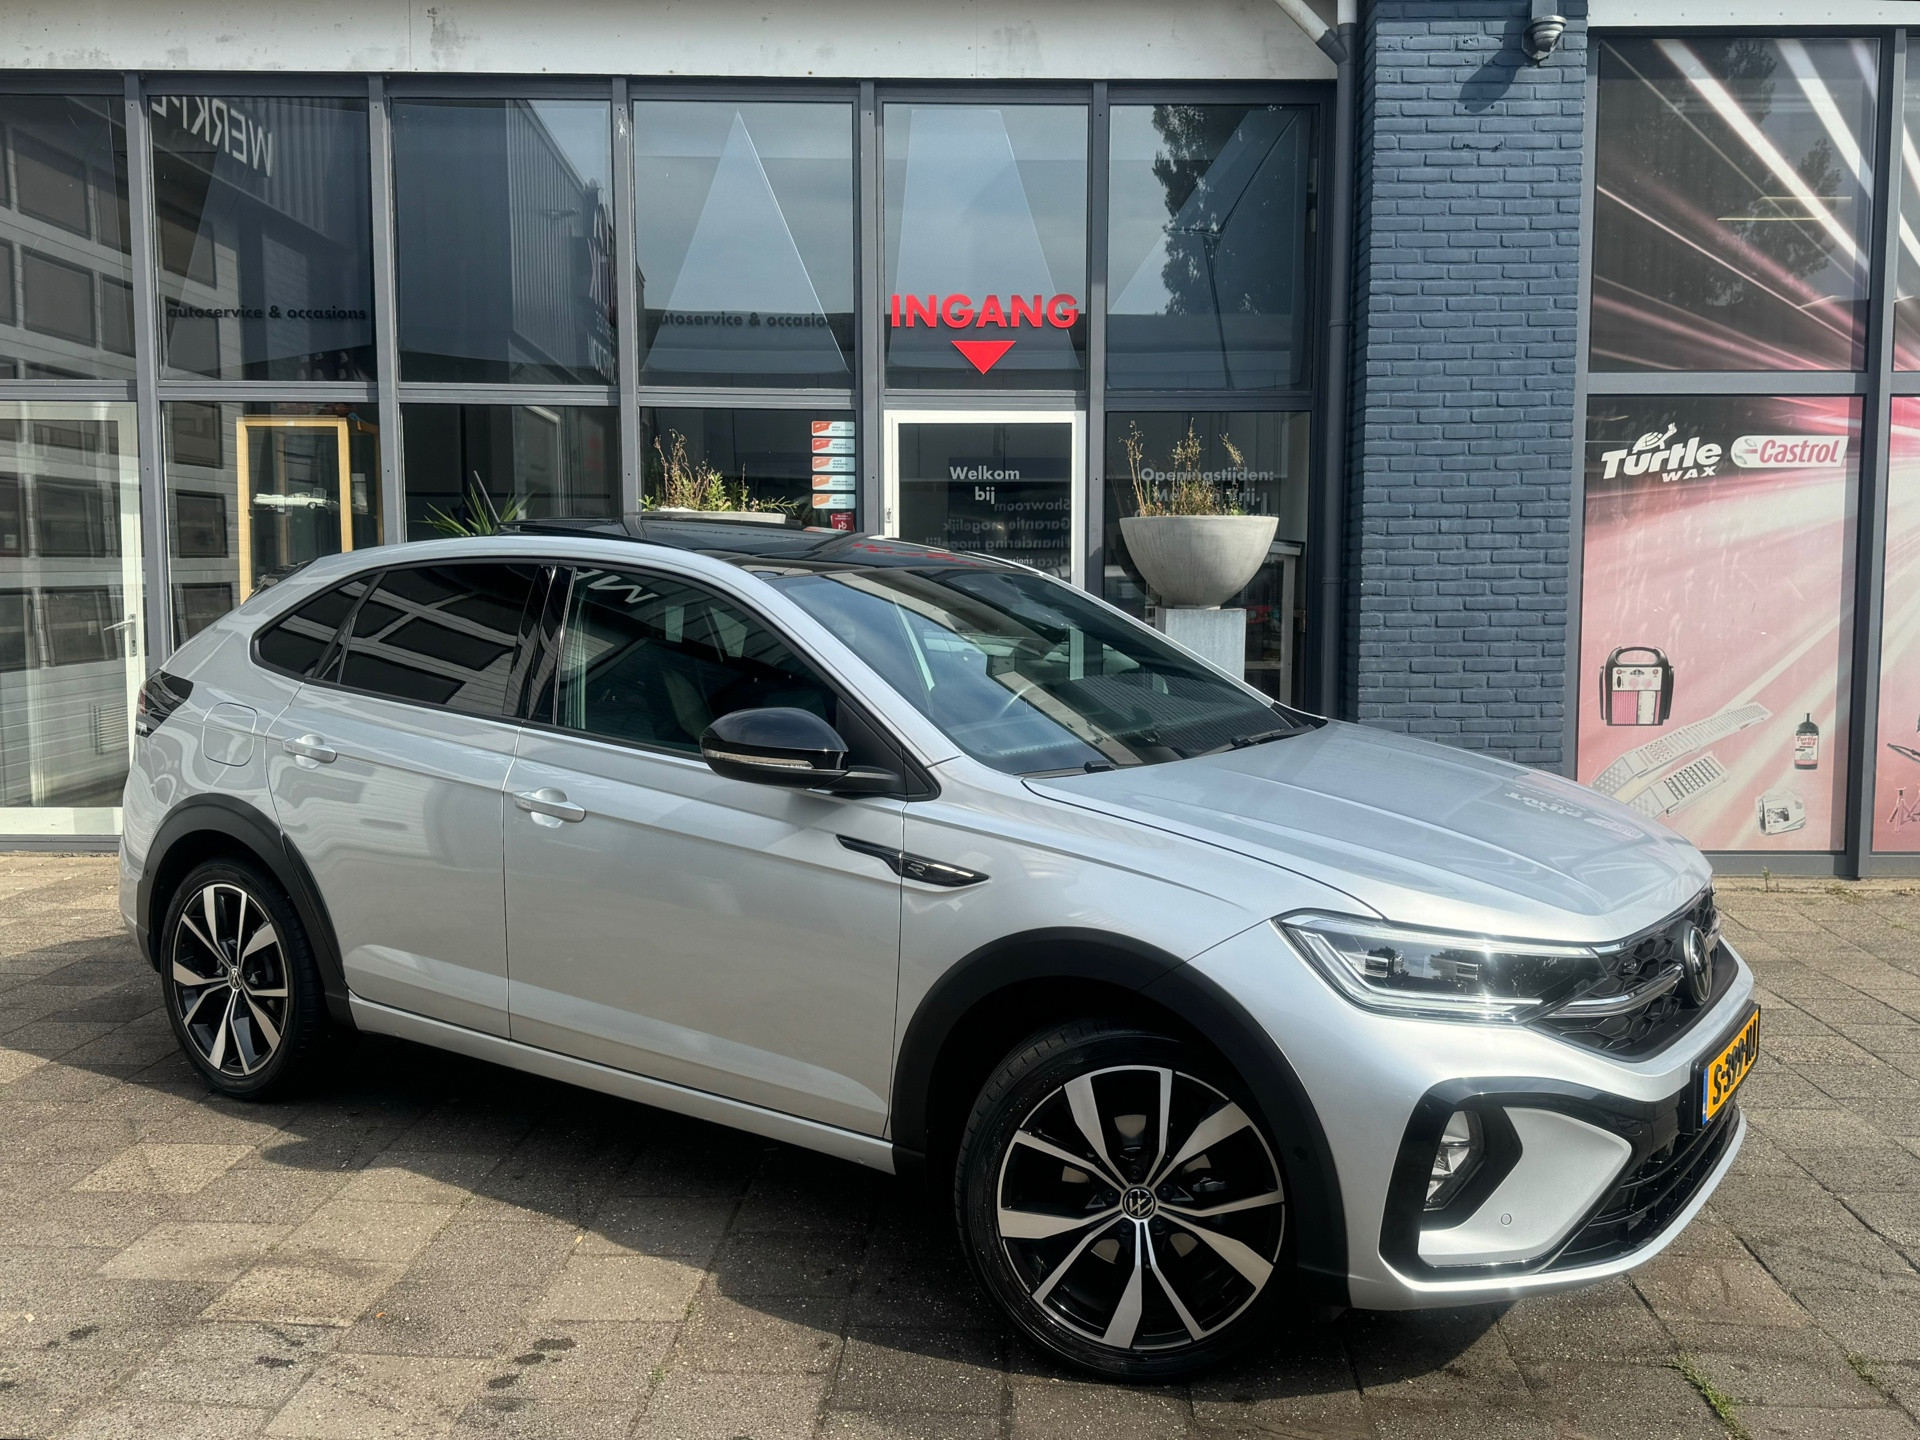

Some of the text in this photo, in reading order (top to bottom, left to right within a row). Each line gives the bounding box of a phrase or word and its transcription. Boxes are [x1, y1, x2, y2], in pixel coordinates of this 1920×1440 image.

[167, 305, 367, 321] autoservice & occasions
[749, 312, 761, 327] &
[891, 294, 1080, 328] INGANG
[1601, 437, 1840, 479] Turtle Castrol
[950, 466, 1020, 480] Welkom
[1662, 466, 1716, 483] WAX
[975, 487, 995, 504] bij
